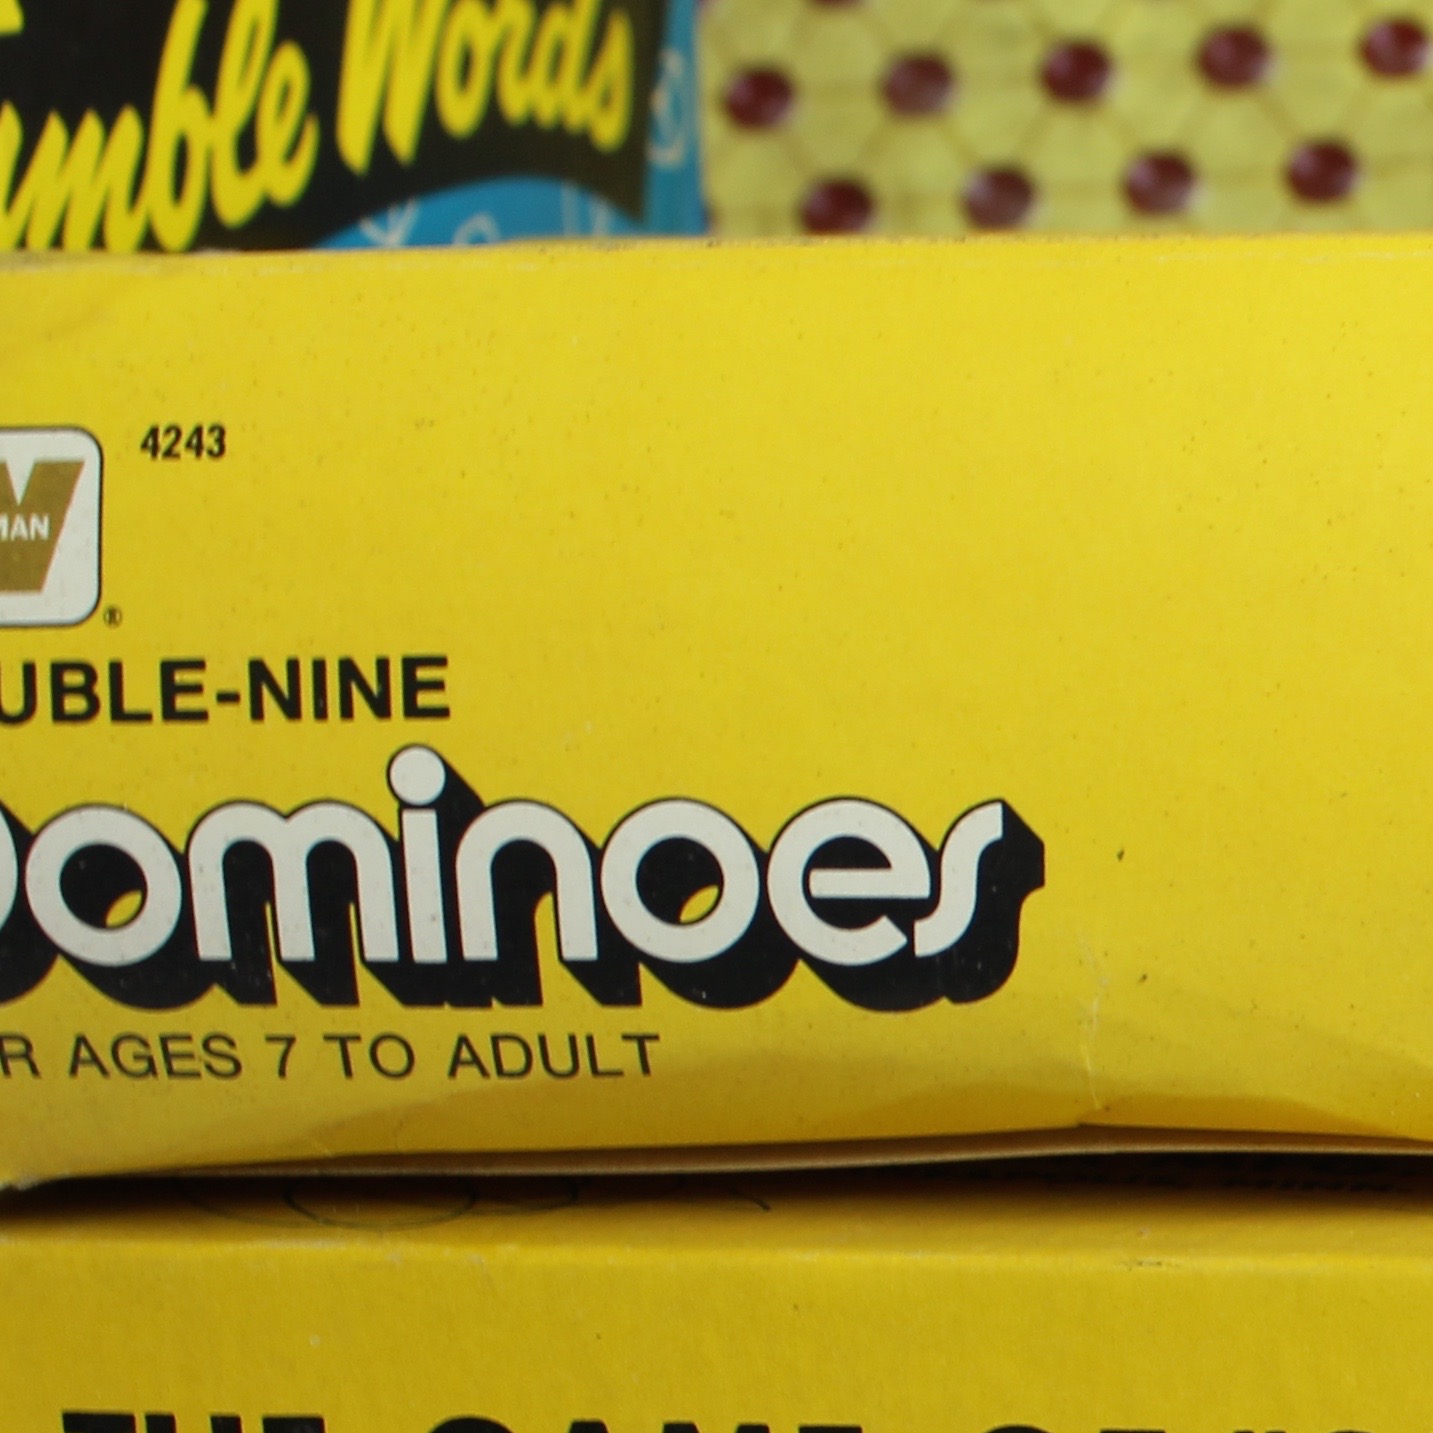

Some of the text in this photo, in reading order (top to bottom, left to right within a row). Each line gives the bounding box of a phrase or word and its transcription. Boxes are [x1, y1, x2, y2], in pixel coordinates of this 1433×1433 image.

[334, 0, 635, 178] Words
[139, 423, 226, 460] 4243
[68, 1032, 242, 1079] AGES
[265, 1034, 297, 1079] 7
[323, 1032, 415, 1079] TO
[447, 1032, 660, 1079] ADULT
